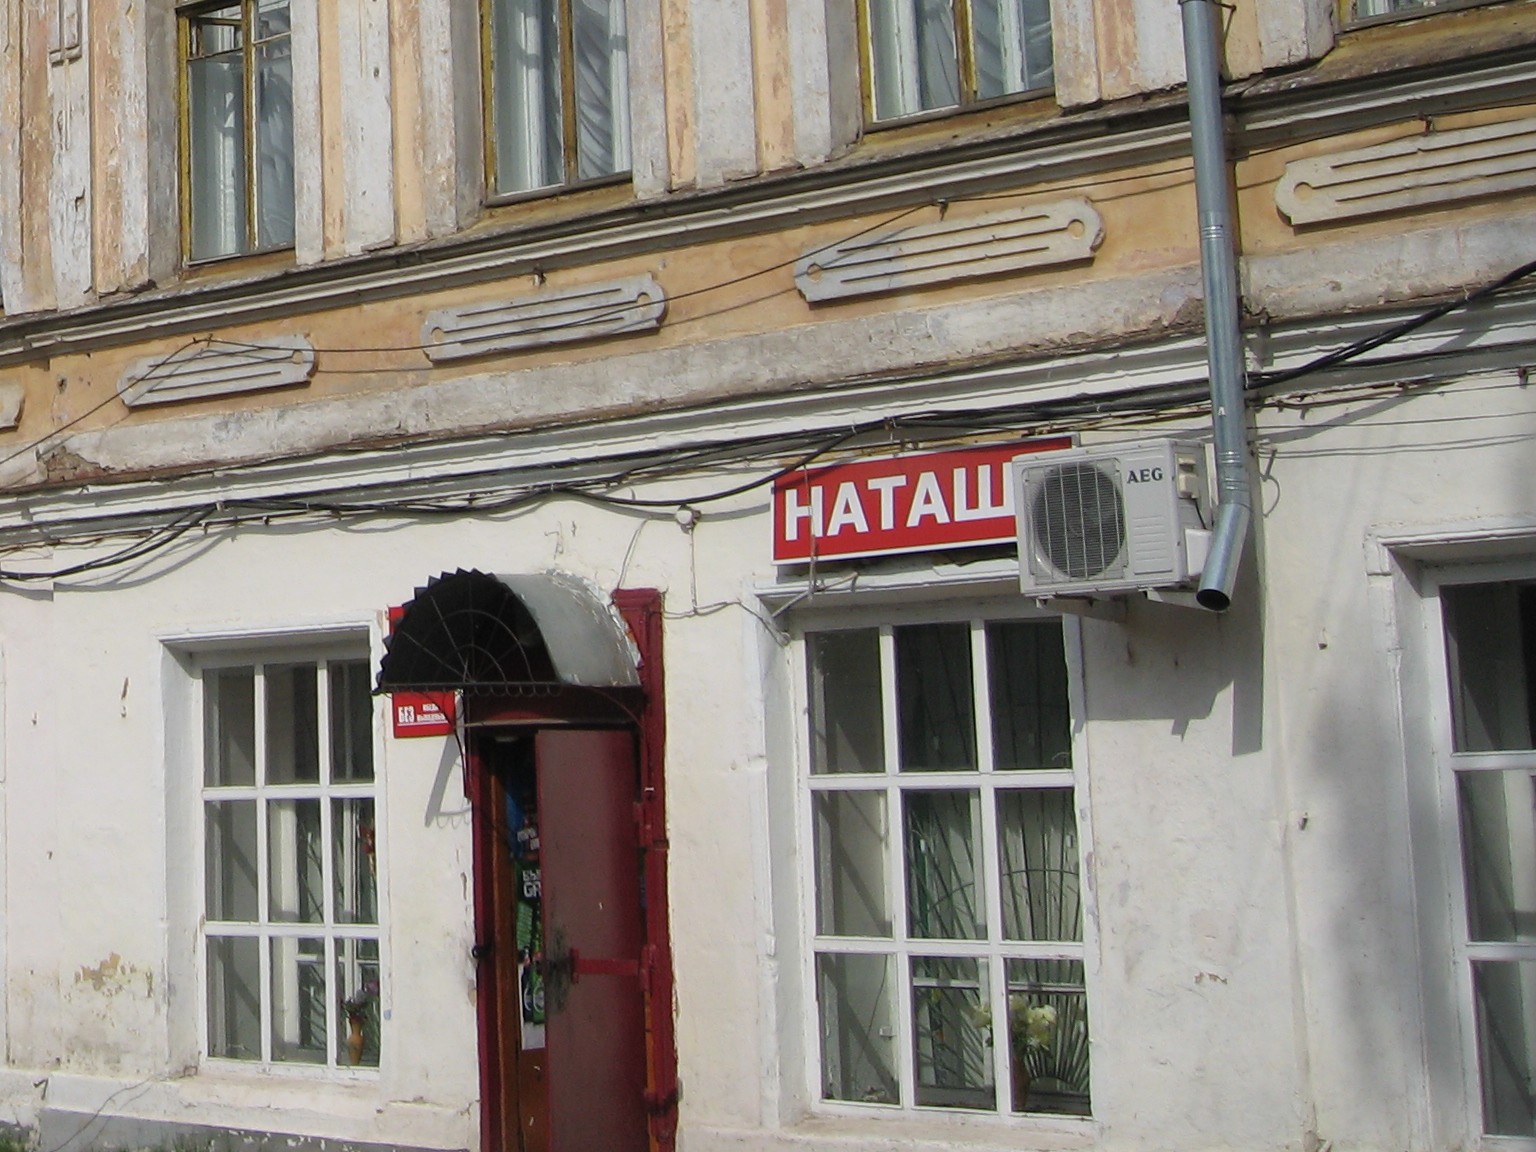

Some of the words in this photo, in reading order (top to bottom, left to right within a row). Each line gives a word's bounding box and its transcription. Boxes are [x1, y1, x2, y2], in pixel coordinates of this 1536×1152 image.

[1126, 467, 1164, 484] AEG
[784, 461, 1016, 542] НАТАШ
[397, 705, 415, 724] БЕЗ
